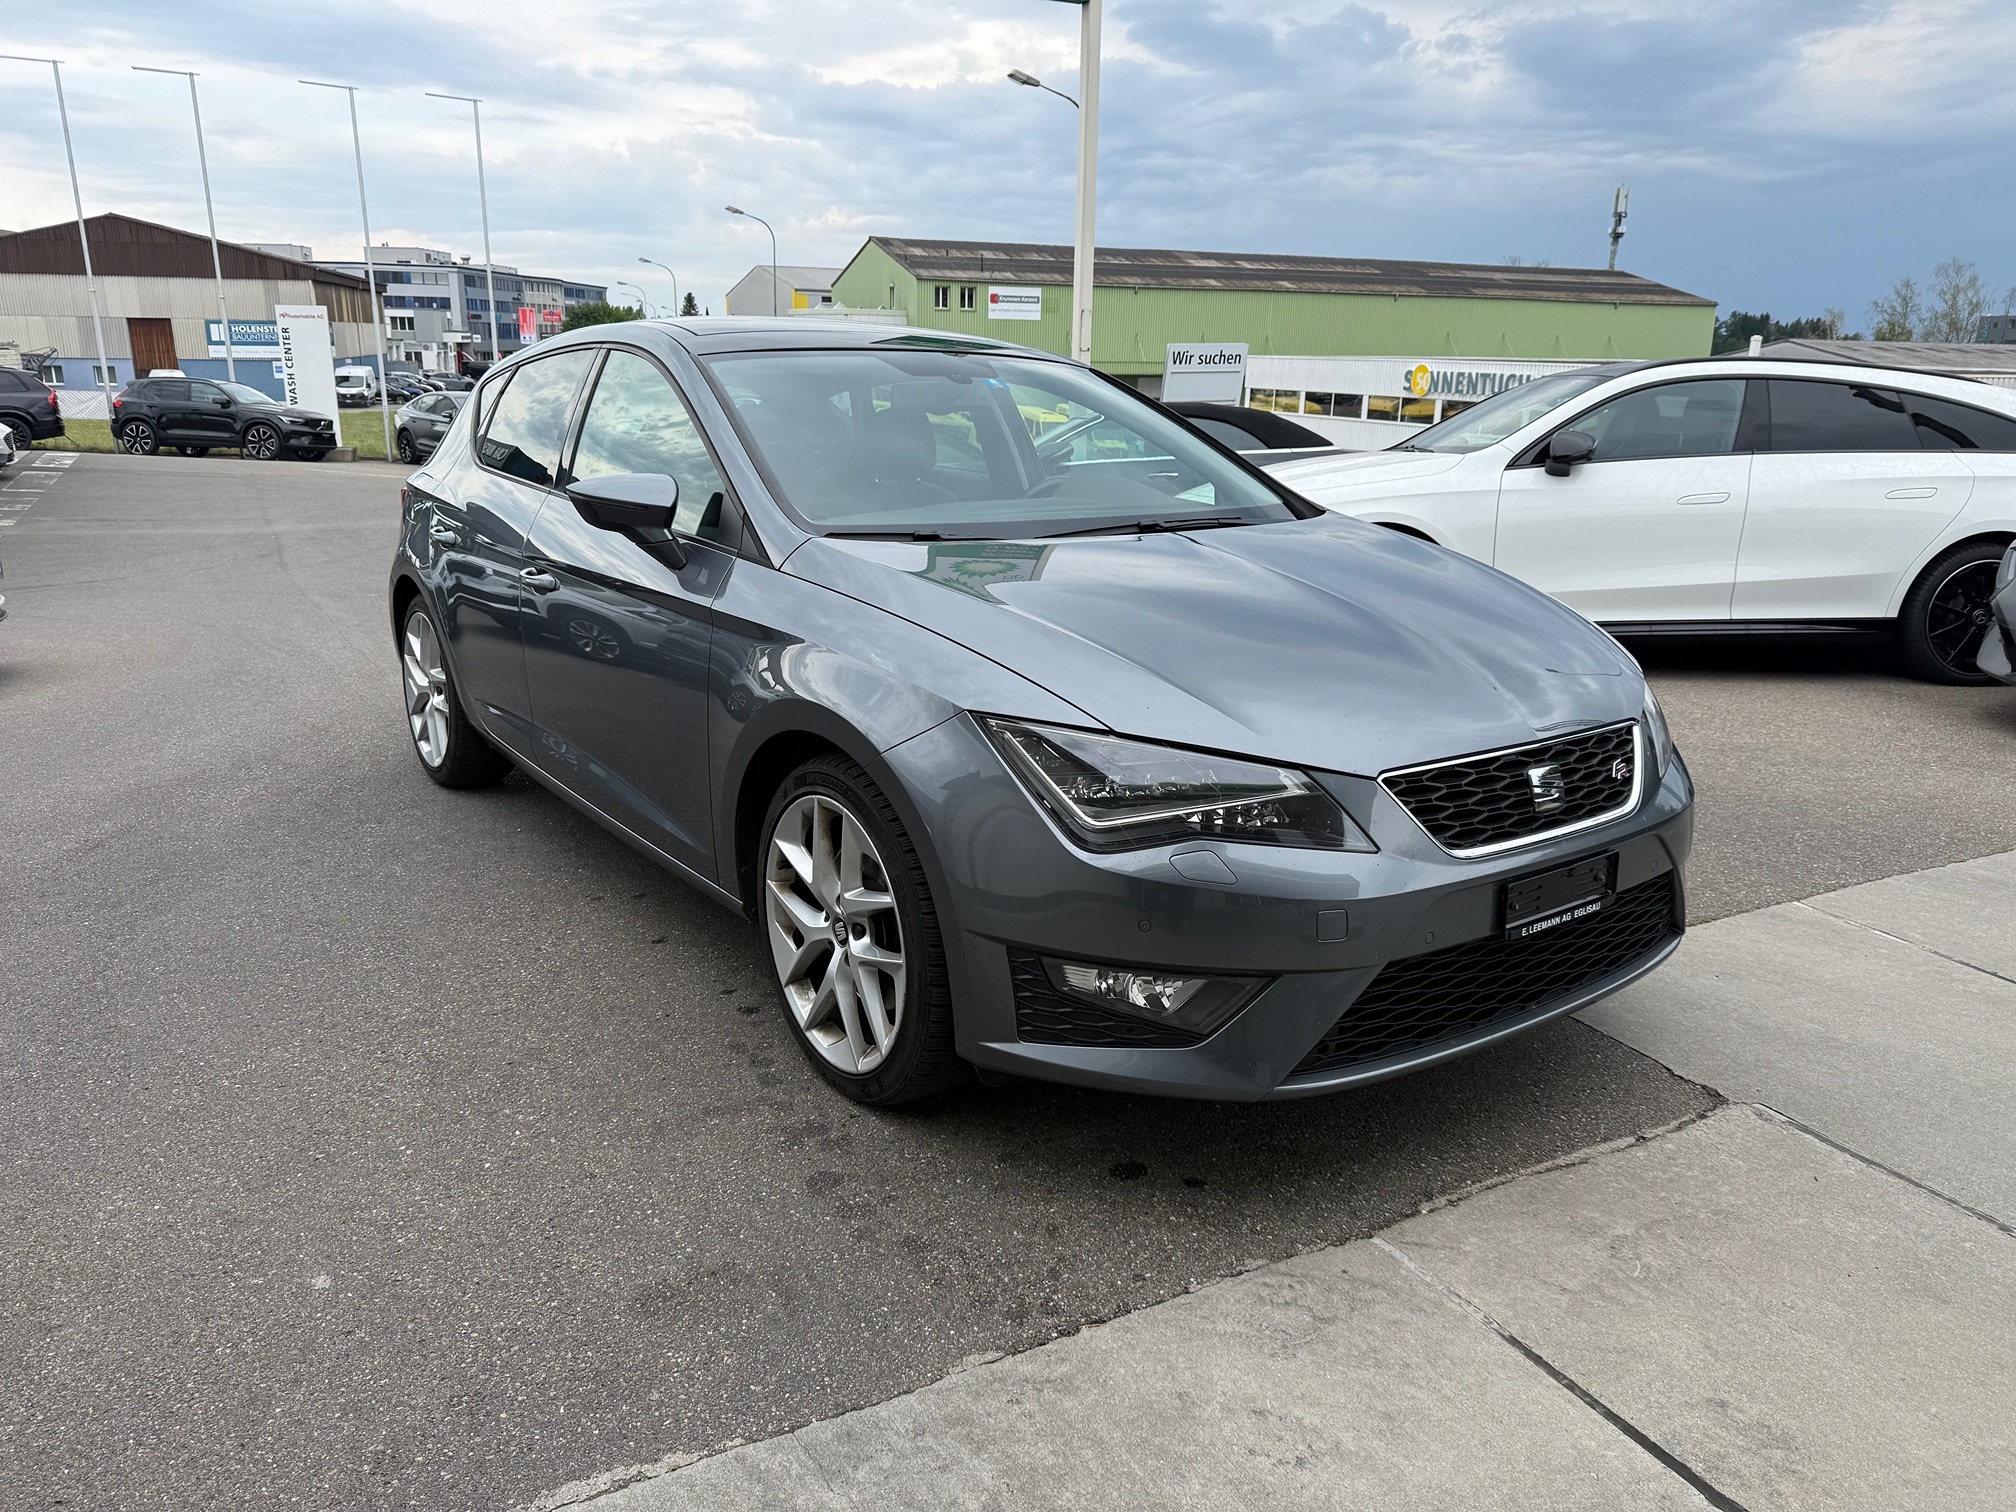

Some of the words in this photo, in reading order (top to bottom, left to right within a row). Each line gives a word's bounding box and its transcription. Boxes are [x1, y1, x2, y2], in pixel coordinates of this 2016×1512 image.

[281, 327, 294, 368] CENTER
[1172, 350, 1194, 365] Wir
[1198, 349, 1242, 365] suchen
[287, 373, 298, 405] WASH
[1522, 927, 1529, 936] E.
[1529, 916, 1561, 934] LEEMANN
[1562, 912, 1572, 923] AG
[1574, 902, 1601, 918] EGLISAU
